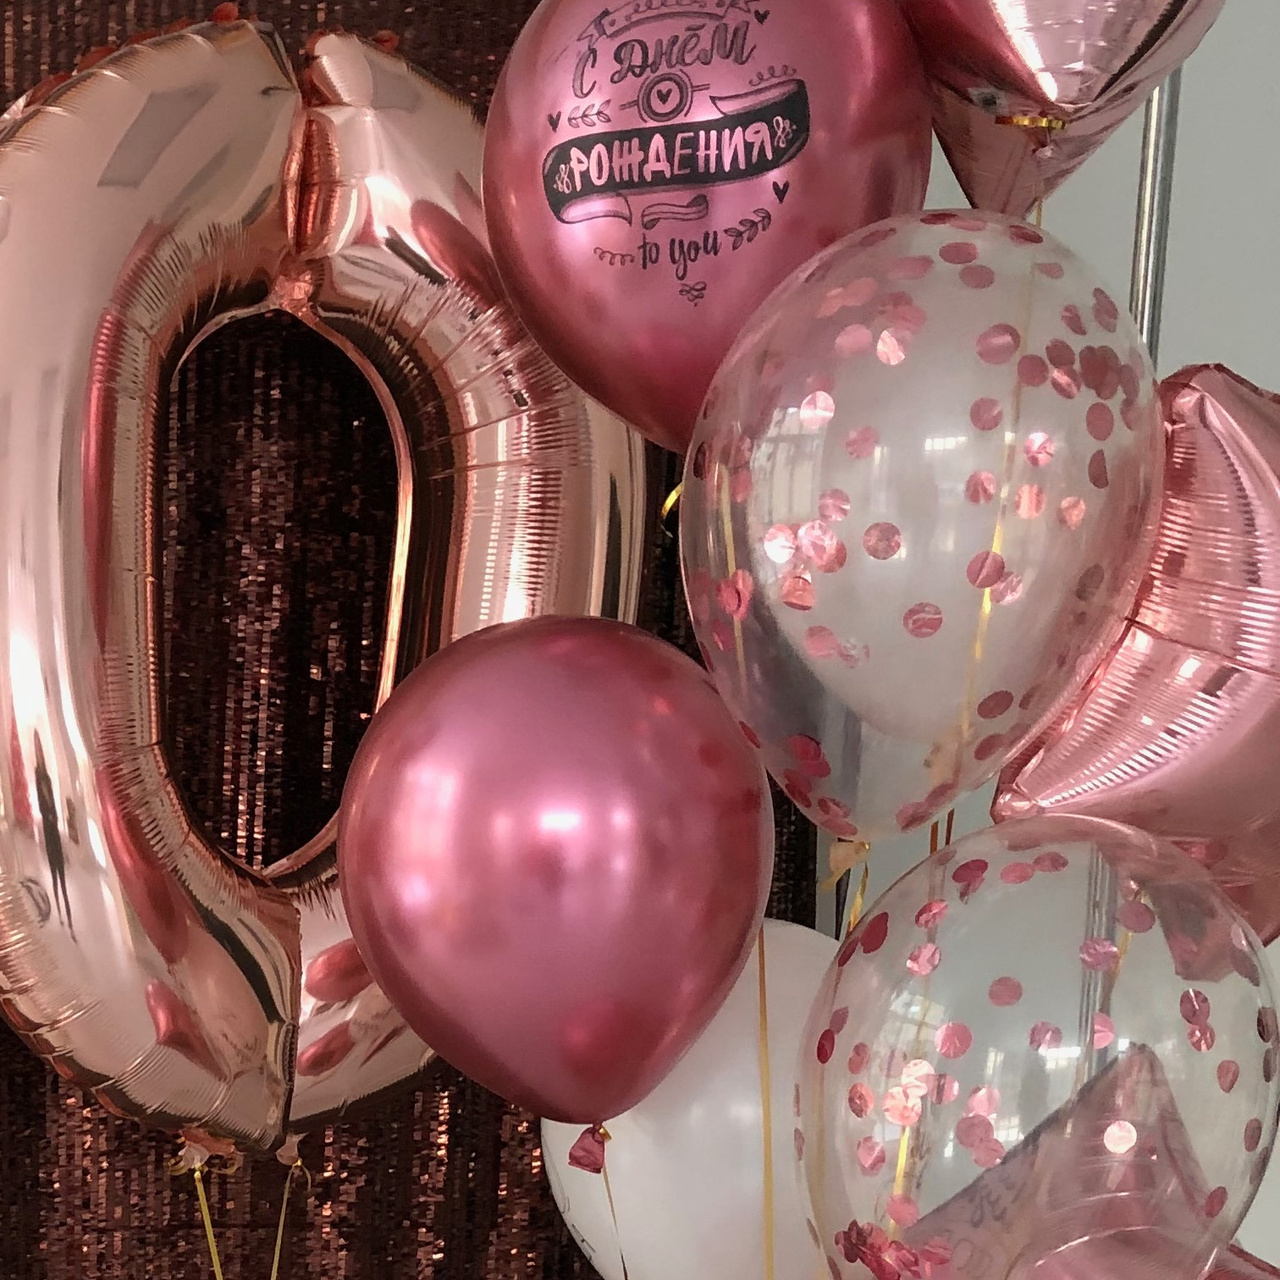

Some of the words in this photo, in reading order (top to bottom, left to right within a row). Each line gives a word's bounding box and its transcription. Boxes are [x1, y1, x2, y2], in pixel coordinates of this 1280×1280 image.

[570, 122, 773, 192] РОЖДЕНИЯ
[637, 233, 660, 270] to
[670, 231, 719, 281] you
